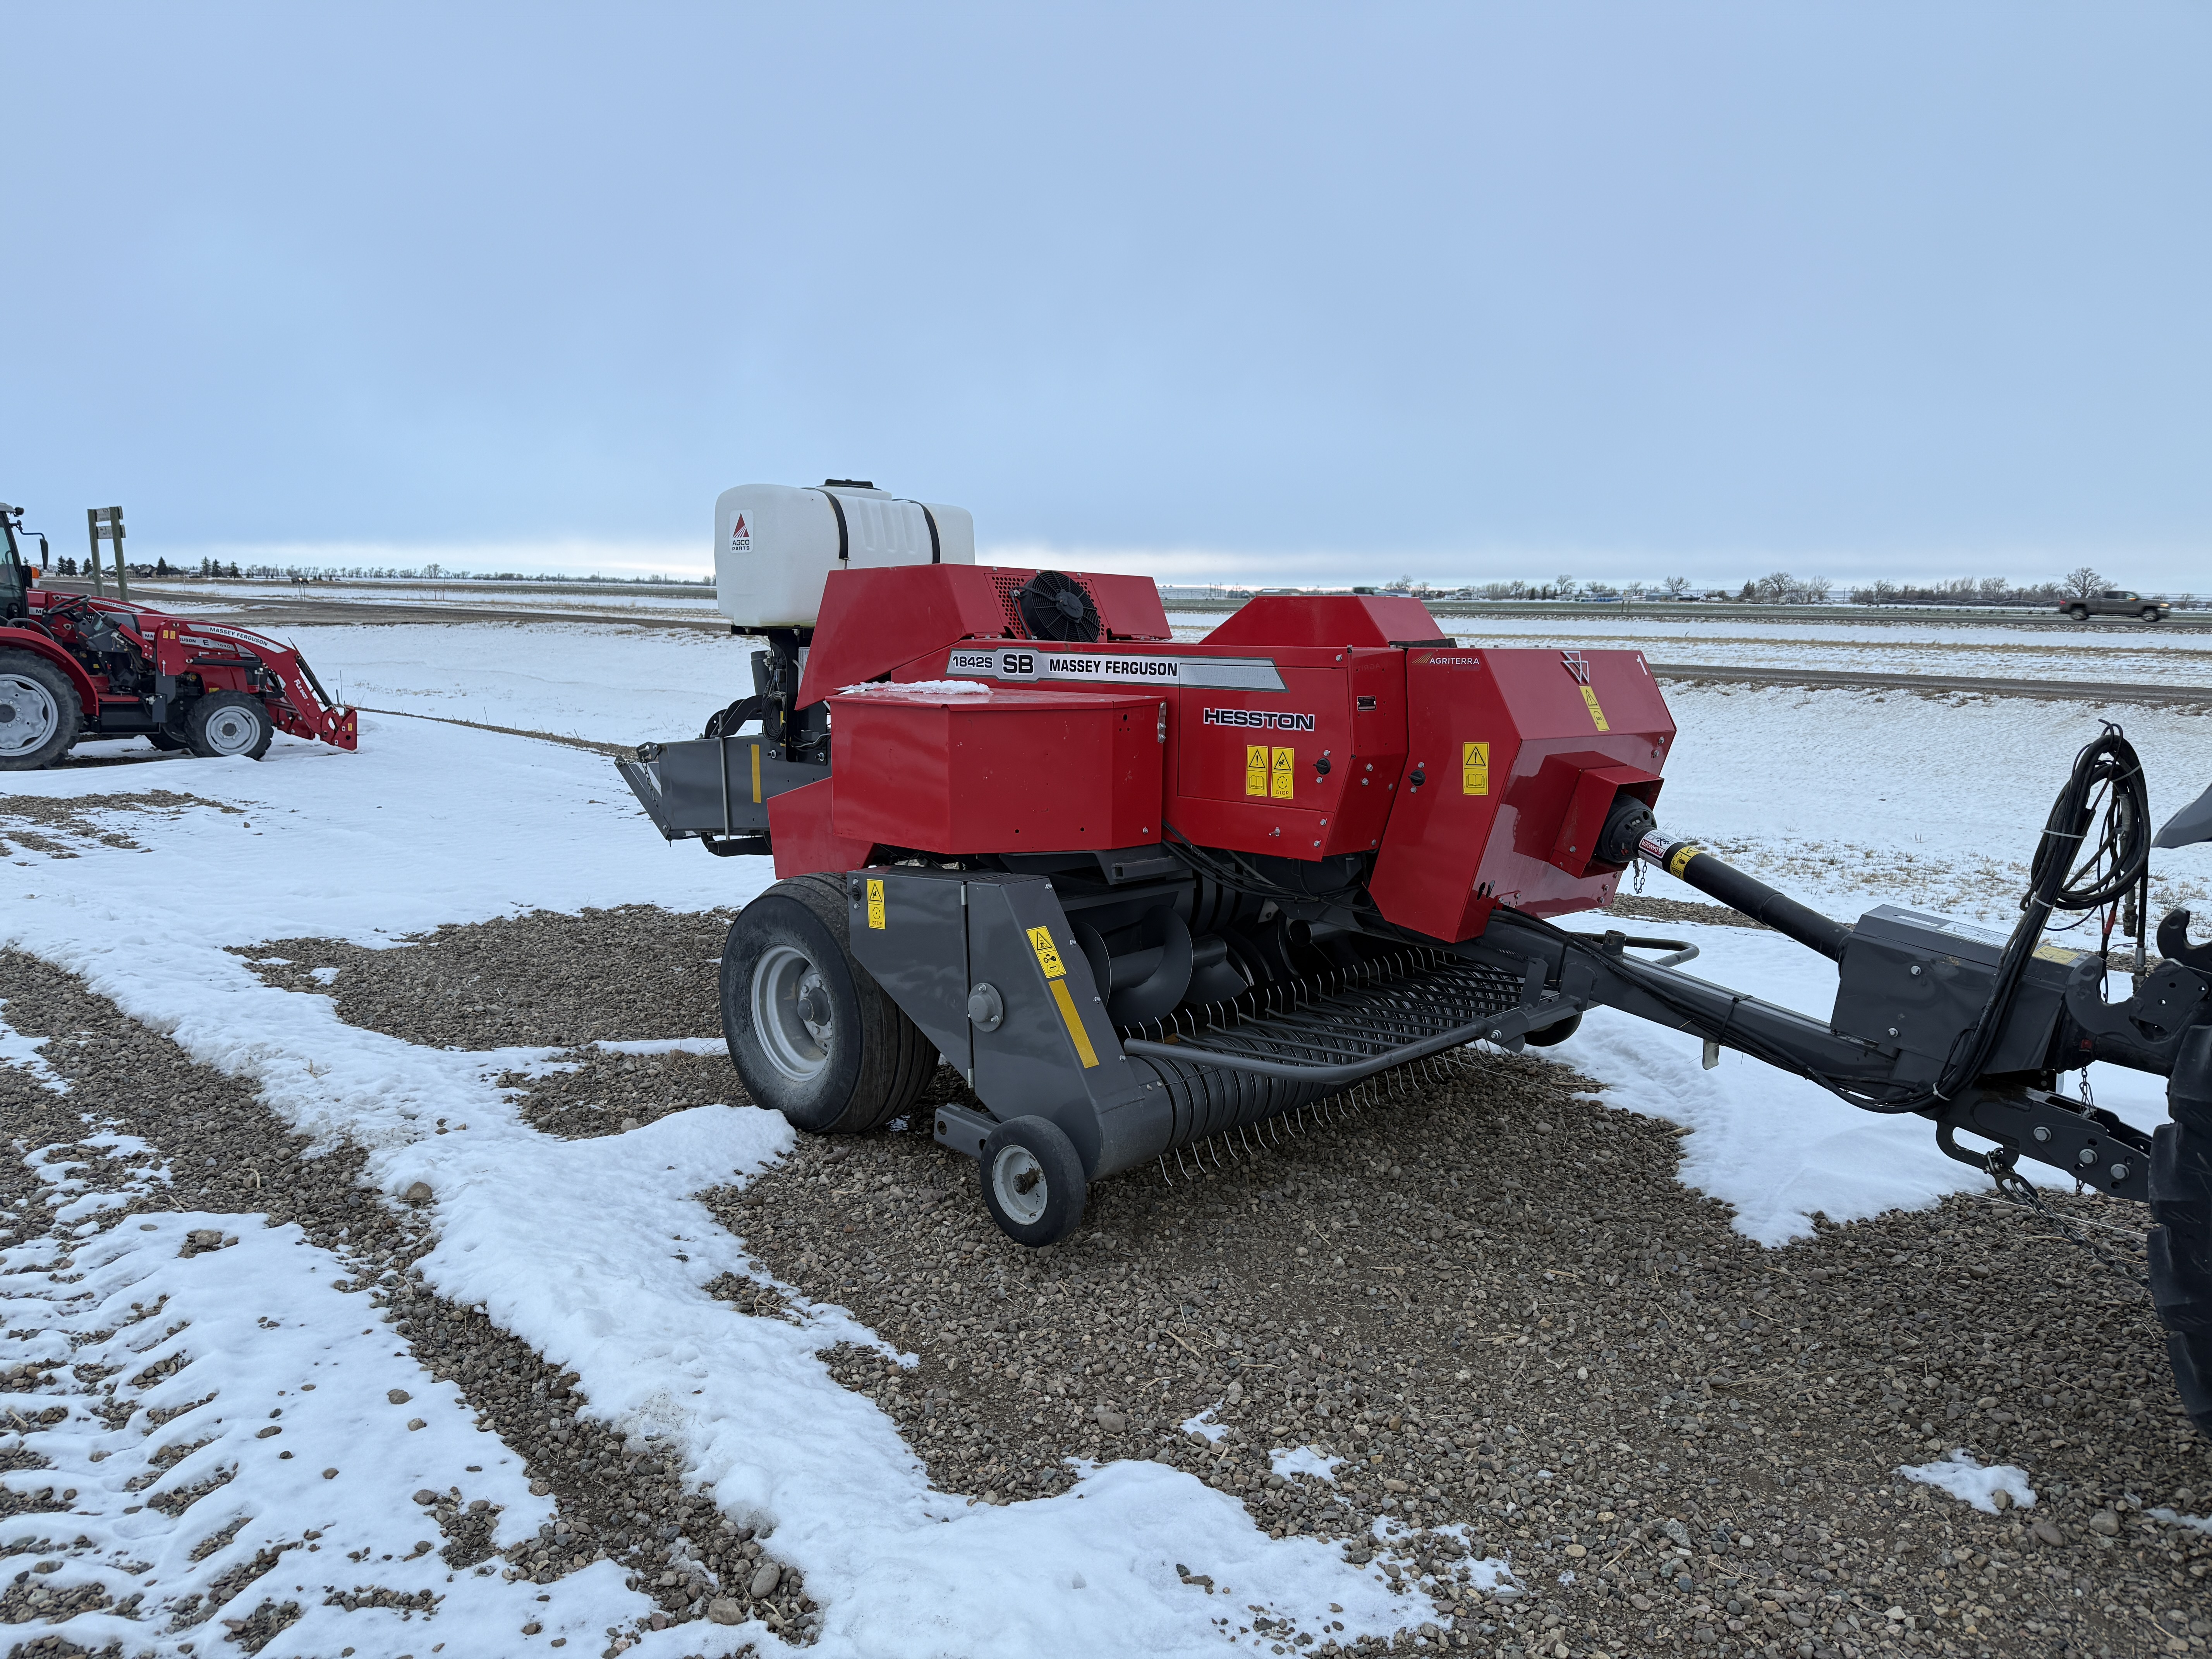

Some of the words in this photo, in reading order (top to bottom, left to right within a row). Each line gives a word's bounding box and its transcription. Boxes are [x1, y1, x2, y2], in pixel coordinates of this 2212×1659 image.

[210, 627, 235, 636] MASSEY
[237, 632, 268, 646] FERGUSON
[952, 656, 993, 668] 1842S
[1003, 654, 1034, 674] SB
[1049, 659, 1101, 673] MASSEY
[1105, 661, 1178, 676] FERGUSON
[1204, 708, 1314, 731] HESSTON
[1641, 840, 1659, 852] DANGER
